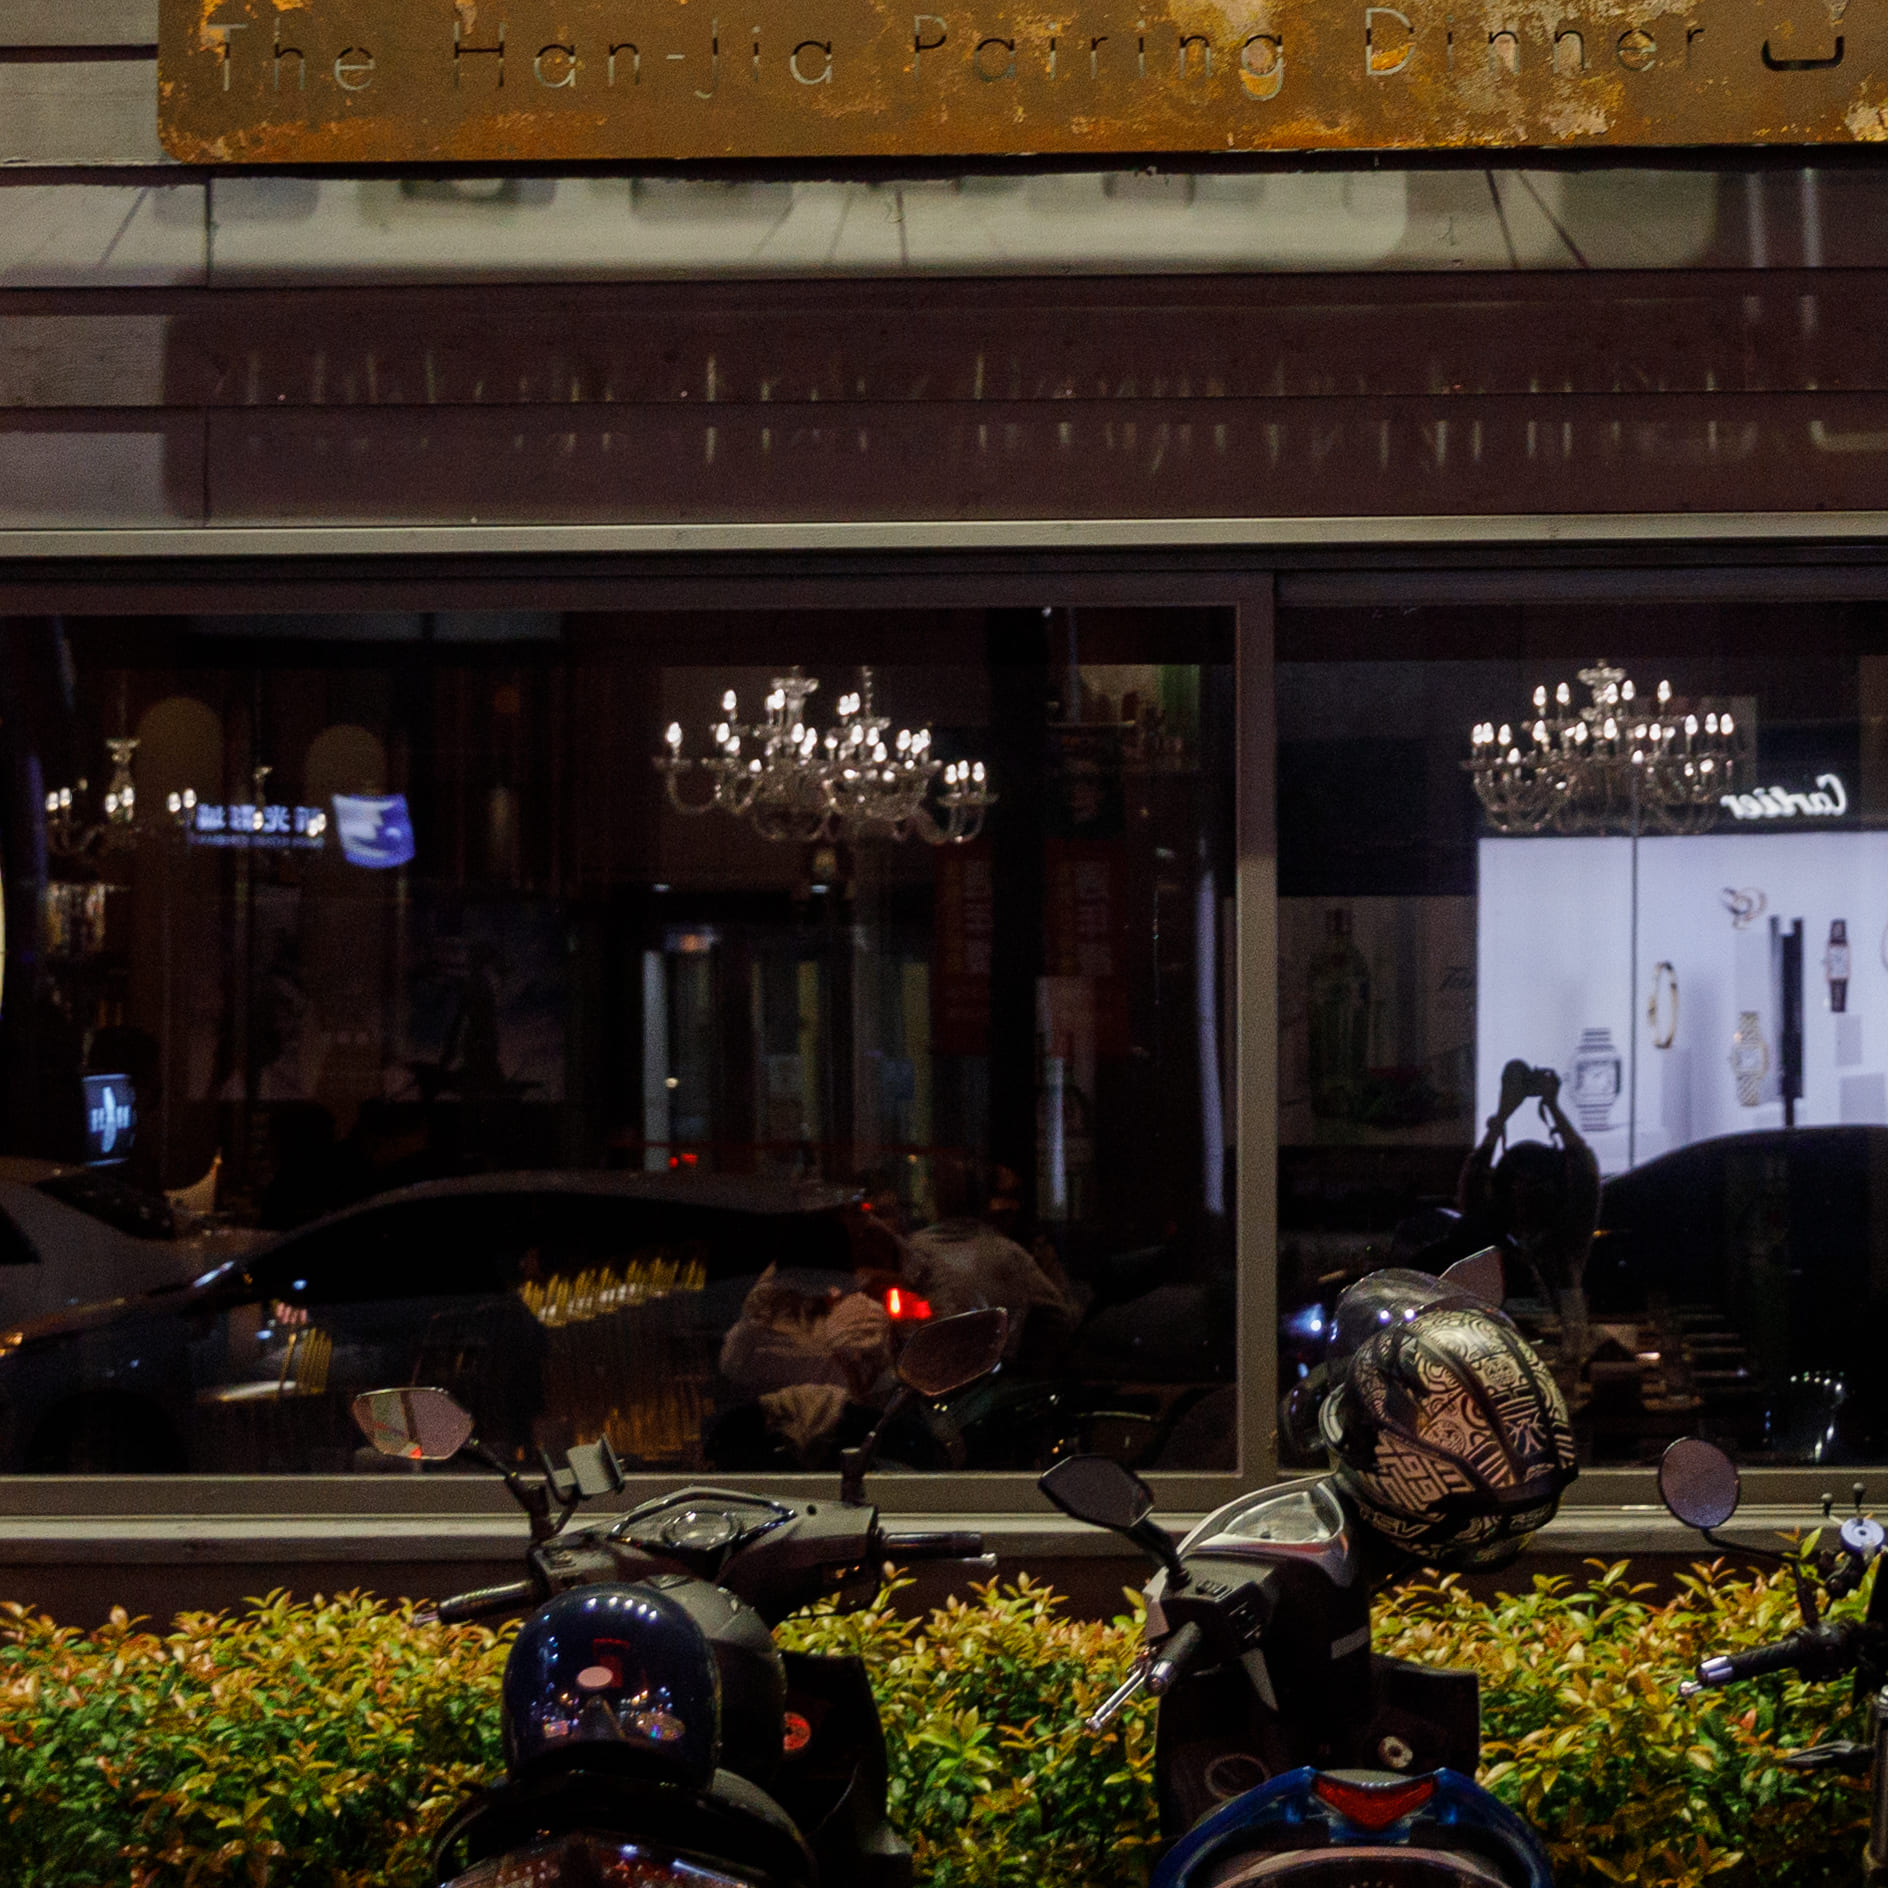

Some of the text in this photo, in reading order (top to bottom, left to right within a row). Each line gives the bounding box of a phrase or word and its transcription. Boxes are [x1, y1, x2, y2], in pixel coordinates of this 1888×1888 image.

[207, 5, 1705, 102] The Han-Jia Pairing Dinner
